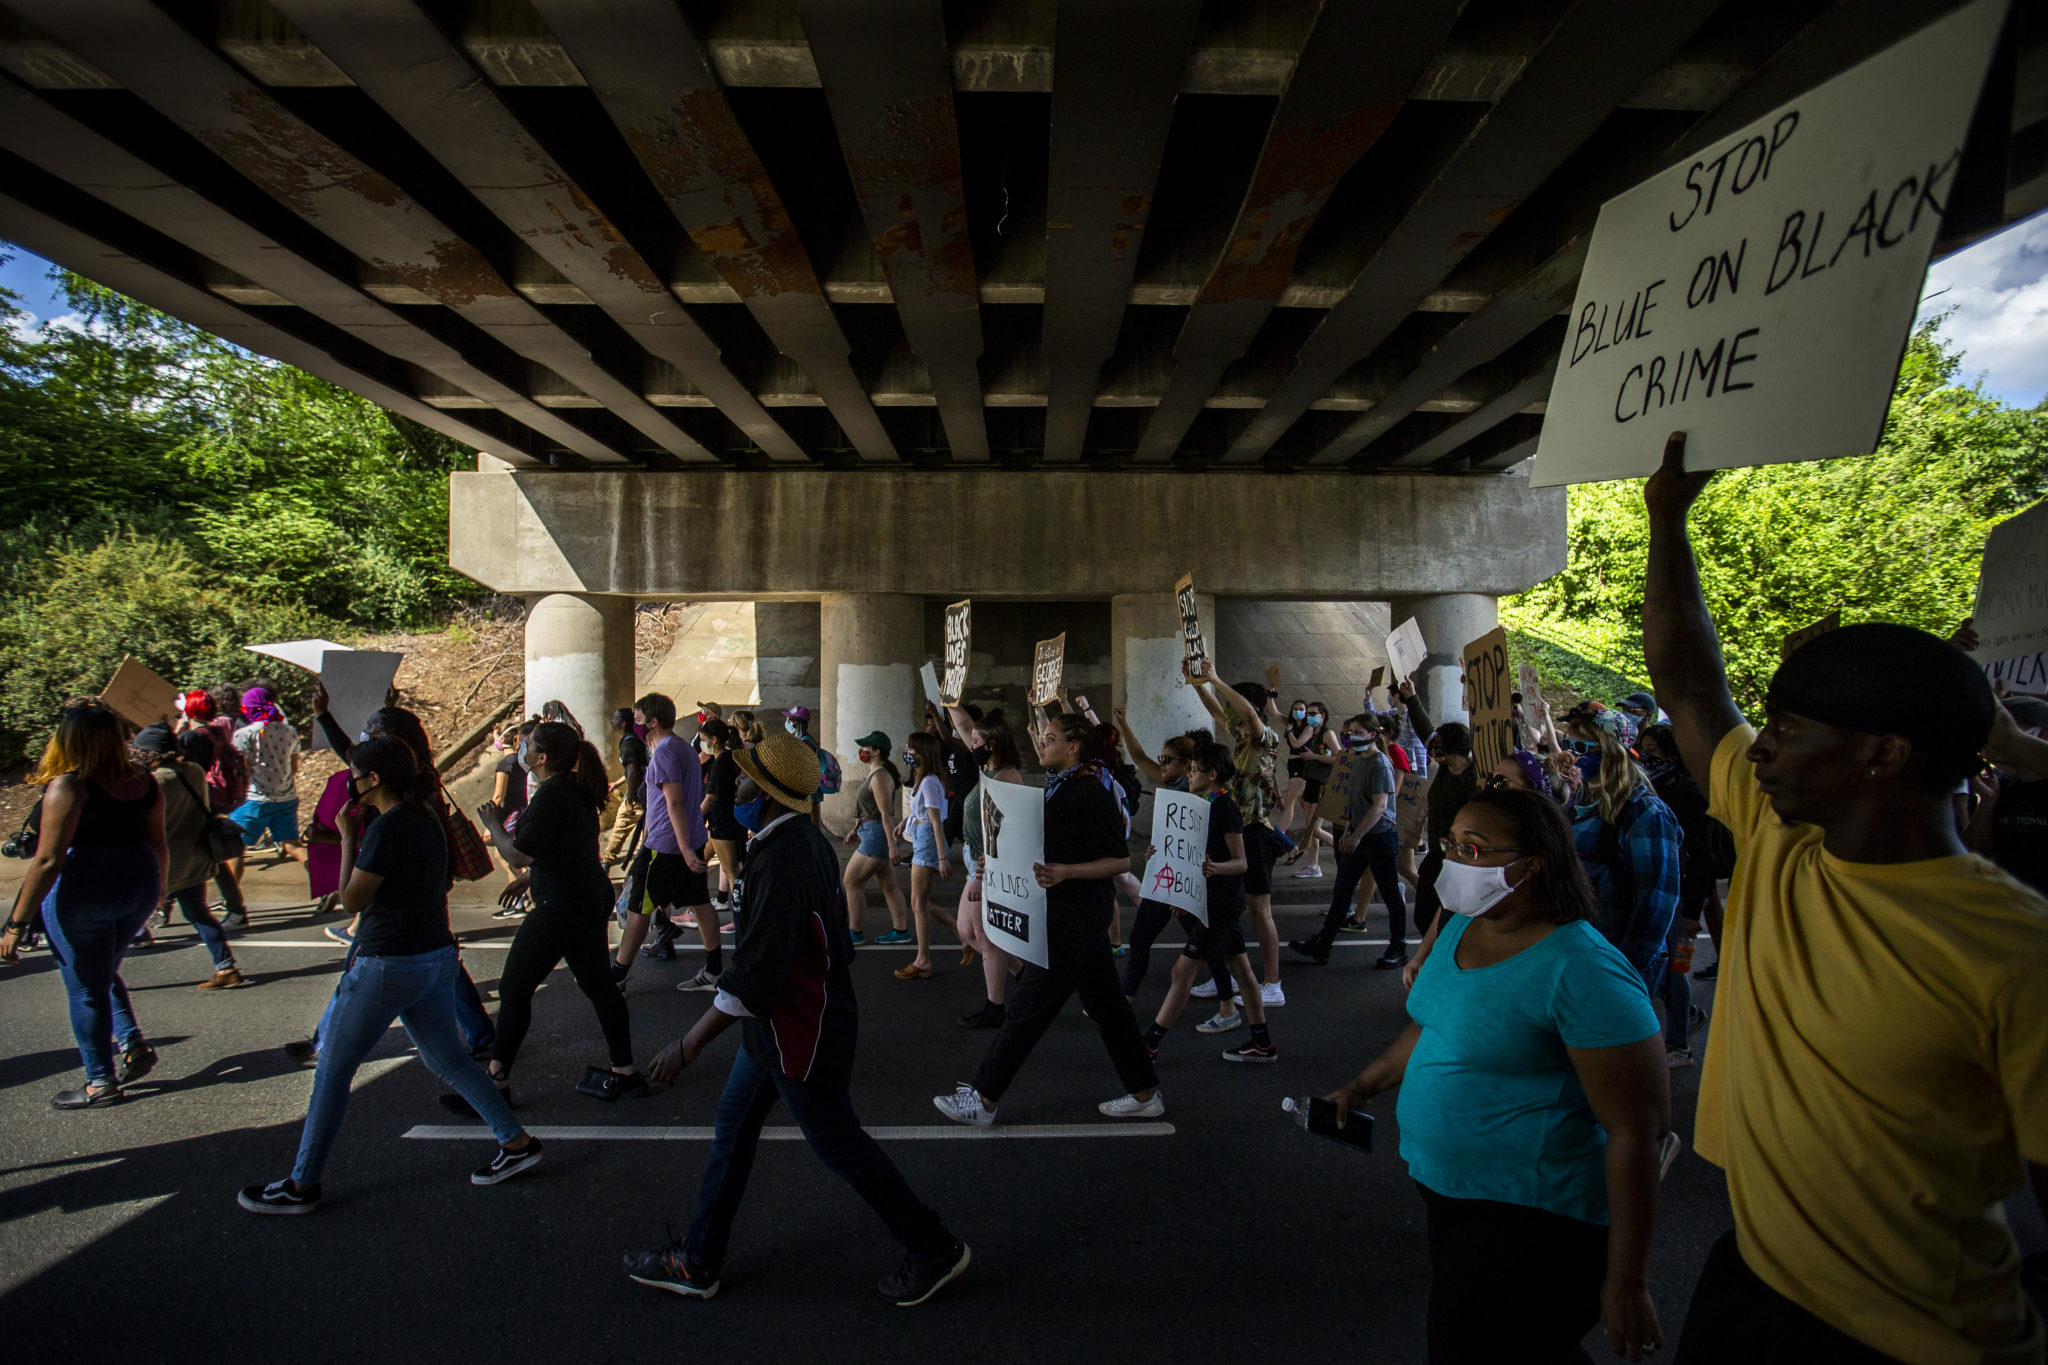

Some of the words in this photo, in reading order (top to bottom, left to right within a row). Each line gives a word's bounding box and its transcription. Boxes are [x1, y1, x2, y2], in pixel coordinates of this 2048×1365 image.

[1669, 110, 1800, 233] STOP
[1570, 279, 1666, 369] BLUE
[1687, 238, 1748, 310] ON
[1765, 148, 1964, 296] BLACK
[1615, 328, 1760, 423] CRIME
[946, 640, 967, 666] LIVES
[947, 606, 969, 643] BLACK
[1467, 644, 1505, 716] STOP
[1001, 872, 1030, 899] LIVES
